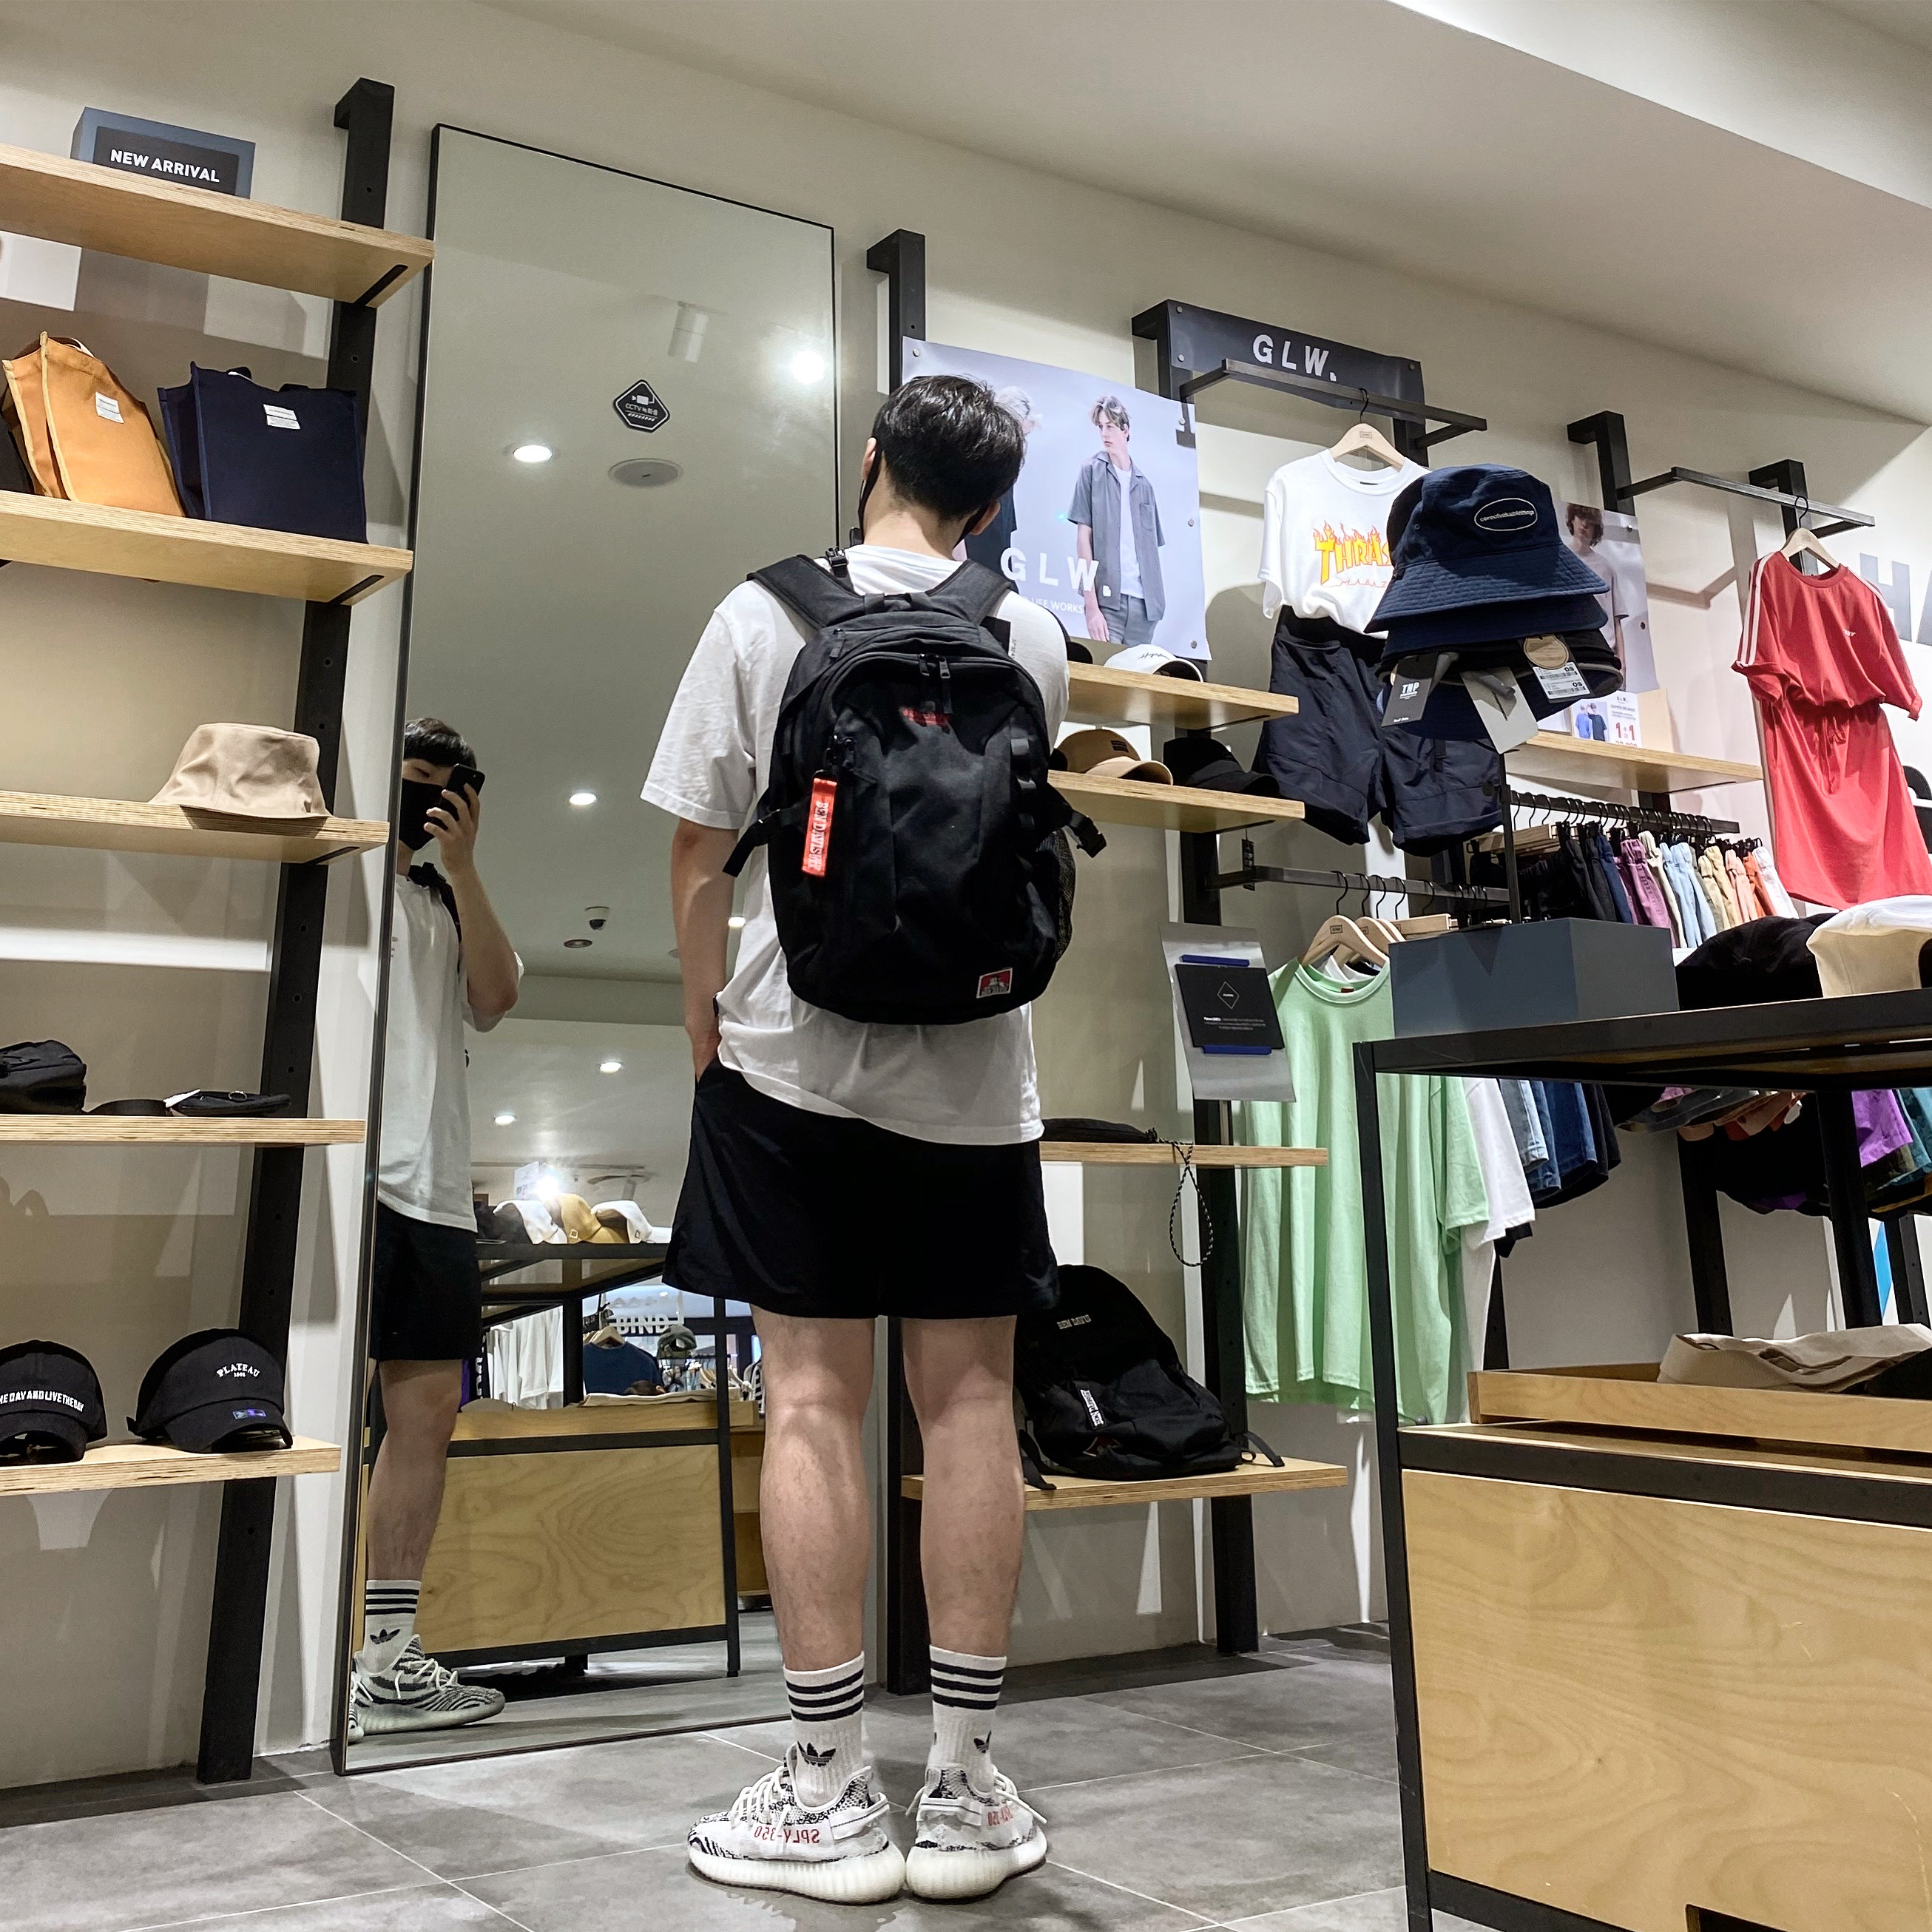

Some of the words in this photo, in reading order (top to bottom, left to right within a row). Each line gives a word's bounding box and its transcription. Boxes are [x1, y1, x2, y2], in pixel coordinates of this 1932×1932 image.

[110, 149, 149, 168] NEW
[150, 158, 220, 183] ARRIVAL
[625, 403, 642, 411] CCTV
[1312, 519, 1392, 586] THRAS
[1340, 578, 1388, 588] MAGAZ
[1050, 600, 1084, 614] WORKS
[216, 1362, 260, 1378] PLATEAU
[9, 1390, 27, 1402] DAY
[27, 1390, 44, 1400] AND
